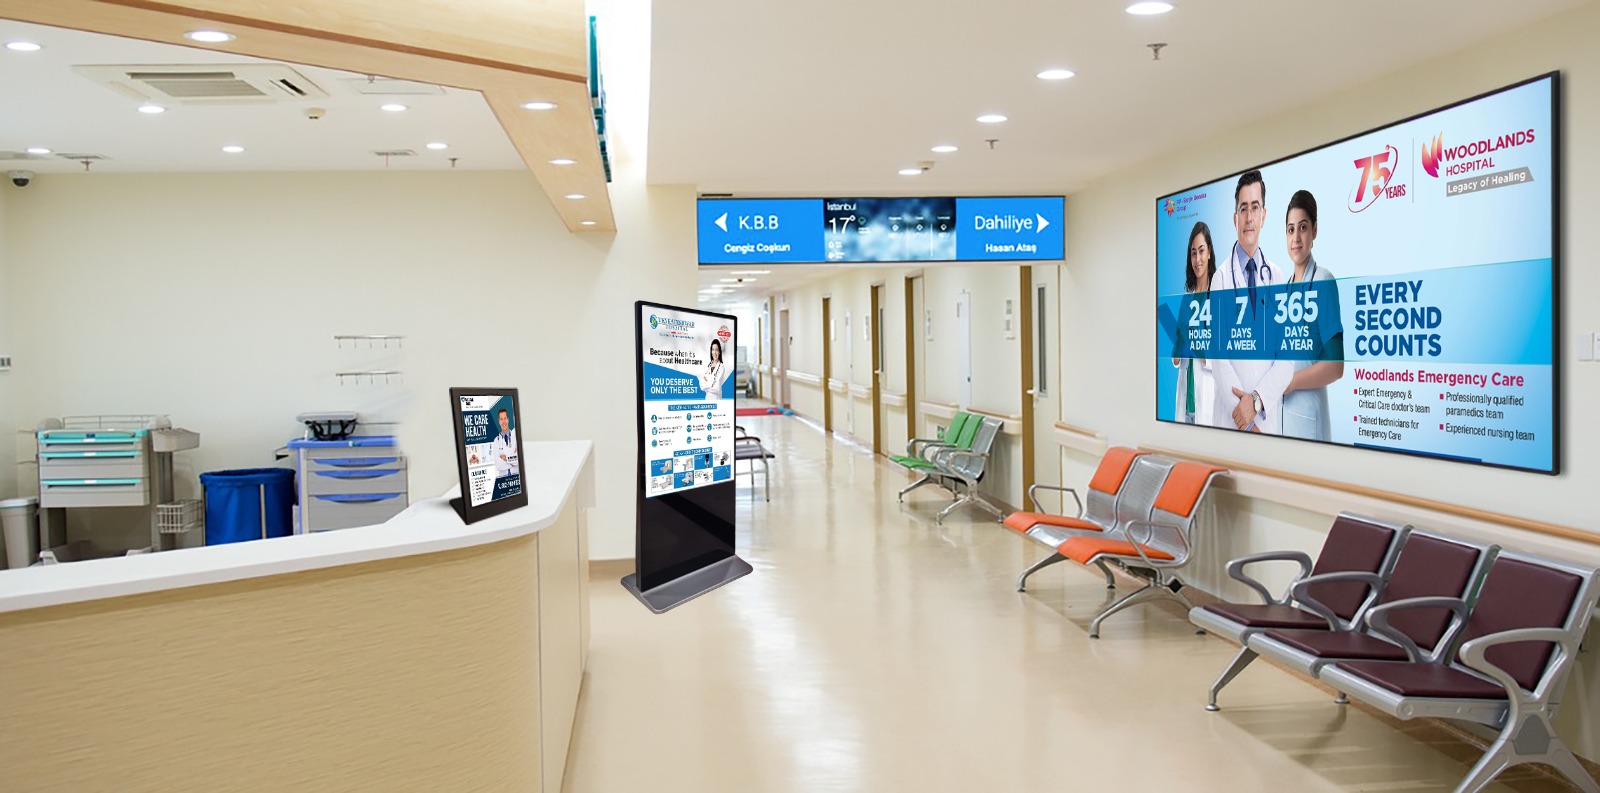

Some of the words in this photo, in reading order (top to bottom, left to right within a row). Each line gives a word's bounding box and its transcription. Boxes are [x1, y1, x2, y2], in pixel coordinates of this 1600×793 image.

[1444, 129, 1535, 161] WOODLANDS
[1446, 157, 1495, 176] HOSPITAL
[1353, 151, 1390, 203] 75
[1385, 184, 1406, 199] YEARS
[1447, 180, 1477, 194] Legacy
[1480, 177, 1490, 187] of
[1491, 171, 1526, 186] Healing
[739, 215, 779, 230] K.B.B
[974, 214, 1033, 233] Dahiliye
[724, 243, 755, 254] Cengiz
[756, 243, 790, 254] Coşkun
[985, 243, 1015, 252] Hasan
[1355, 280, 1423, 305] EVERY
[1189, 299, 1212, 327] 24
[1235, 296, 1248, 325] 7
[1274, 291, 1319, 324] 365
[1355, 306, 1442, 331] SECOND
[1189, 329, 1212, 340] HOURS
[1231, 328, 1252, 339] DAYS
[1285, 326, 1309, 338] DAYS
[1190, 341, 1195, 350] A
[1196, 341, 1210, 350] DAY
[1227, 340, 1233, 350] A
[1234, 340, 1256, 350] WEEK
[1281, 340, 1287, 350] A
[1288, 339, 1313, 350] YEAR
[1355, 334, 1442, 357] COUNTS
[650, 348, 674, 357] Because
[651, 378, 664, 386] YOU
[666, 378, 694, 386] DESERVE
[1354, 368, 1414, 382] Woodlands
[1418, 370, 1487, 388] Emergency
[1491, 372, 1524, 387] Care
[650, 386, 669, 394] ONLY
[670, 386, 682, 394] THE
[683, 386, 698, 394] BEST
[1359, 387, 1375, 397] Expert
[1376, 388, 1406, 400] Emergency
[1408, 390, 1412, 399] &
[1359, 399, 1376, 409] Critical
[1378, 401, 1390, 411] Care
[1391, 402, 1413, 413] doctor's
[1415, 404, 1430, 413] team
[1446, 392, 1492, 406] Professionally
[1493, 395, 1524, 406] qualified
[464, 414, 474, 426] WE
[474, 414, 489, 426] CARE
[1446, 407, 1484, 418] paramedics
[1486, 409, 1504, 419] team
[1359, 415, 1377, 425] Trained
[1379, 417, 1409, 429] technicians
[1411, 420, 1419, 429] for
[465, 425, 487, 437] HEALTH
[1359, 427, 1387, 440] Emergency
[1388, 430, 1401, 441] Care
[1446, 423, 1486, 436] Experienced
[1487, 428, 1513, 441] nursing
[1515, 430, 1535, 441] team
